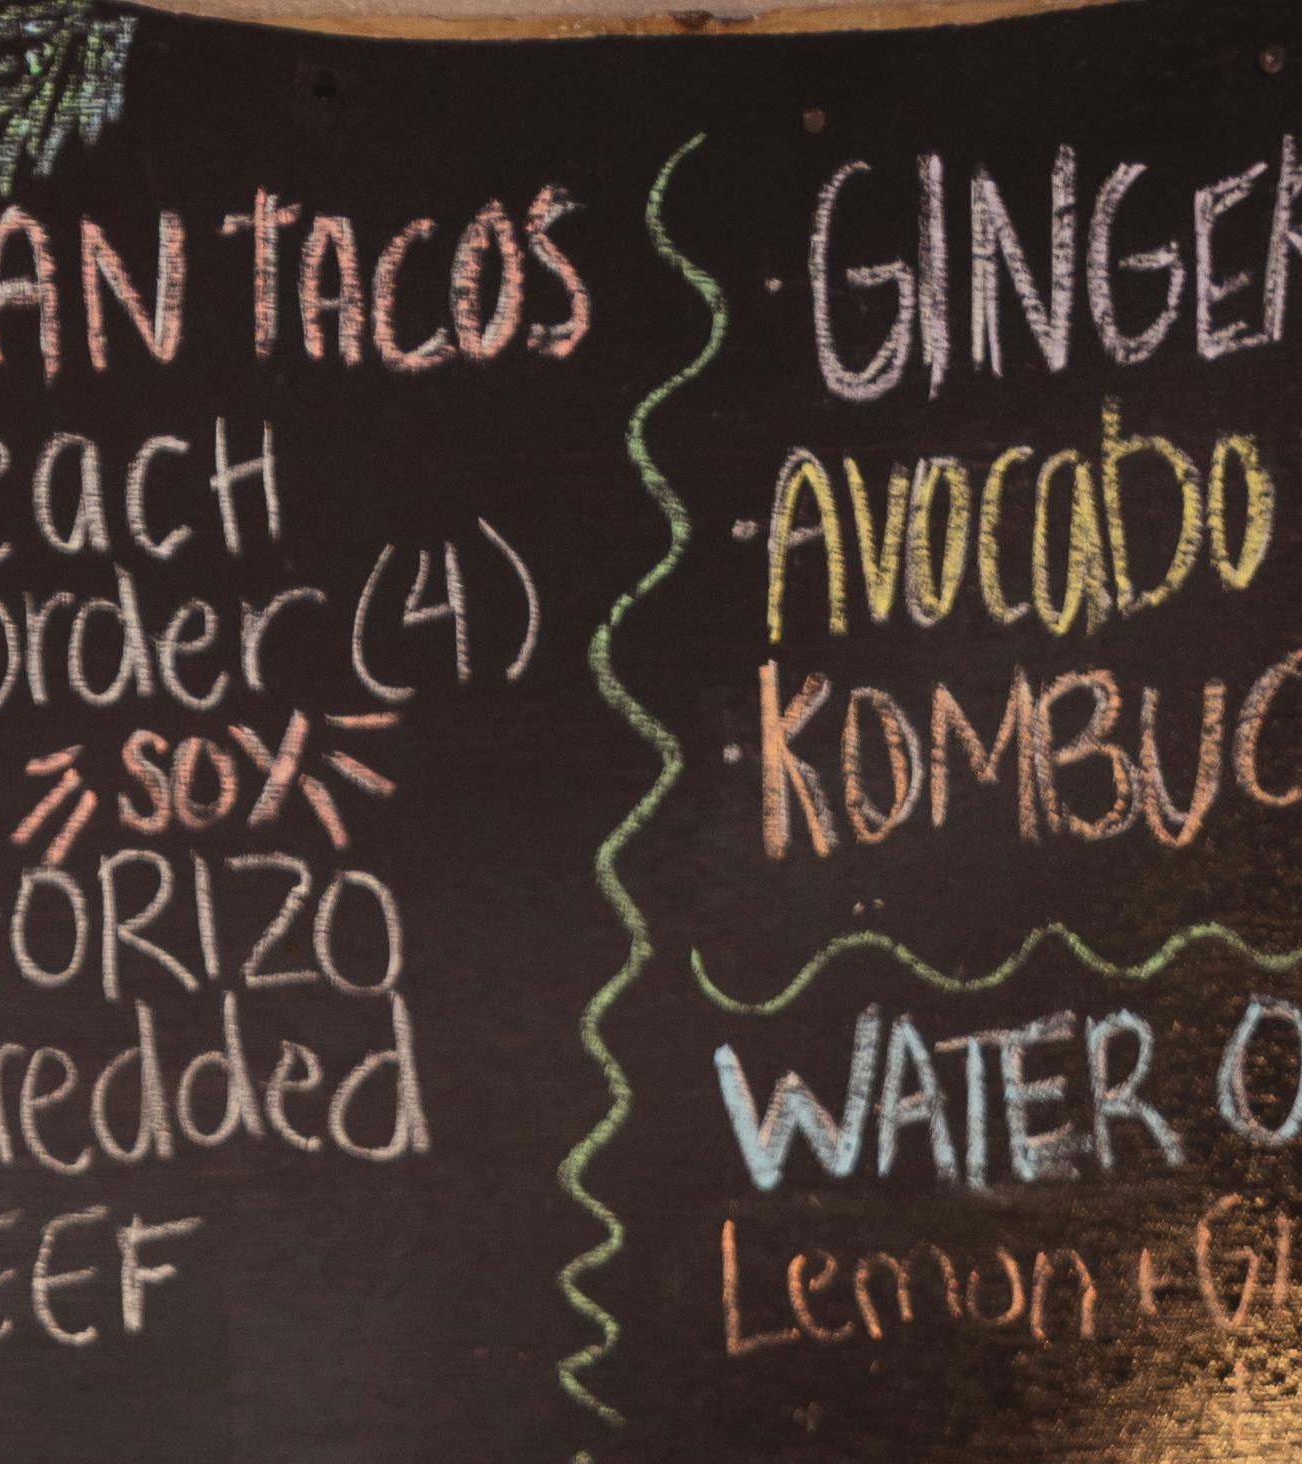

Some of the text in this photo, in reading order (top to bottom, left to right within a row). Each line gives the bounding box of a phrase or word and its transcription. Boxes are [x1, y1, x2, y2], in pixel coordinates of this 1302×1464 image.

[352, 518, 540, 703] (4)
[759, 648, 1302, 860] KOMBUC
[713, 1003, 1185, 1193] WATER
[722, 1218, 1095, 1357] Lemon
